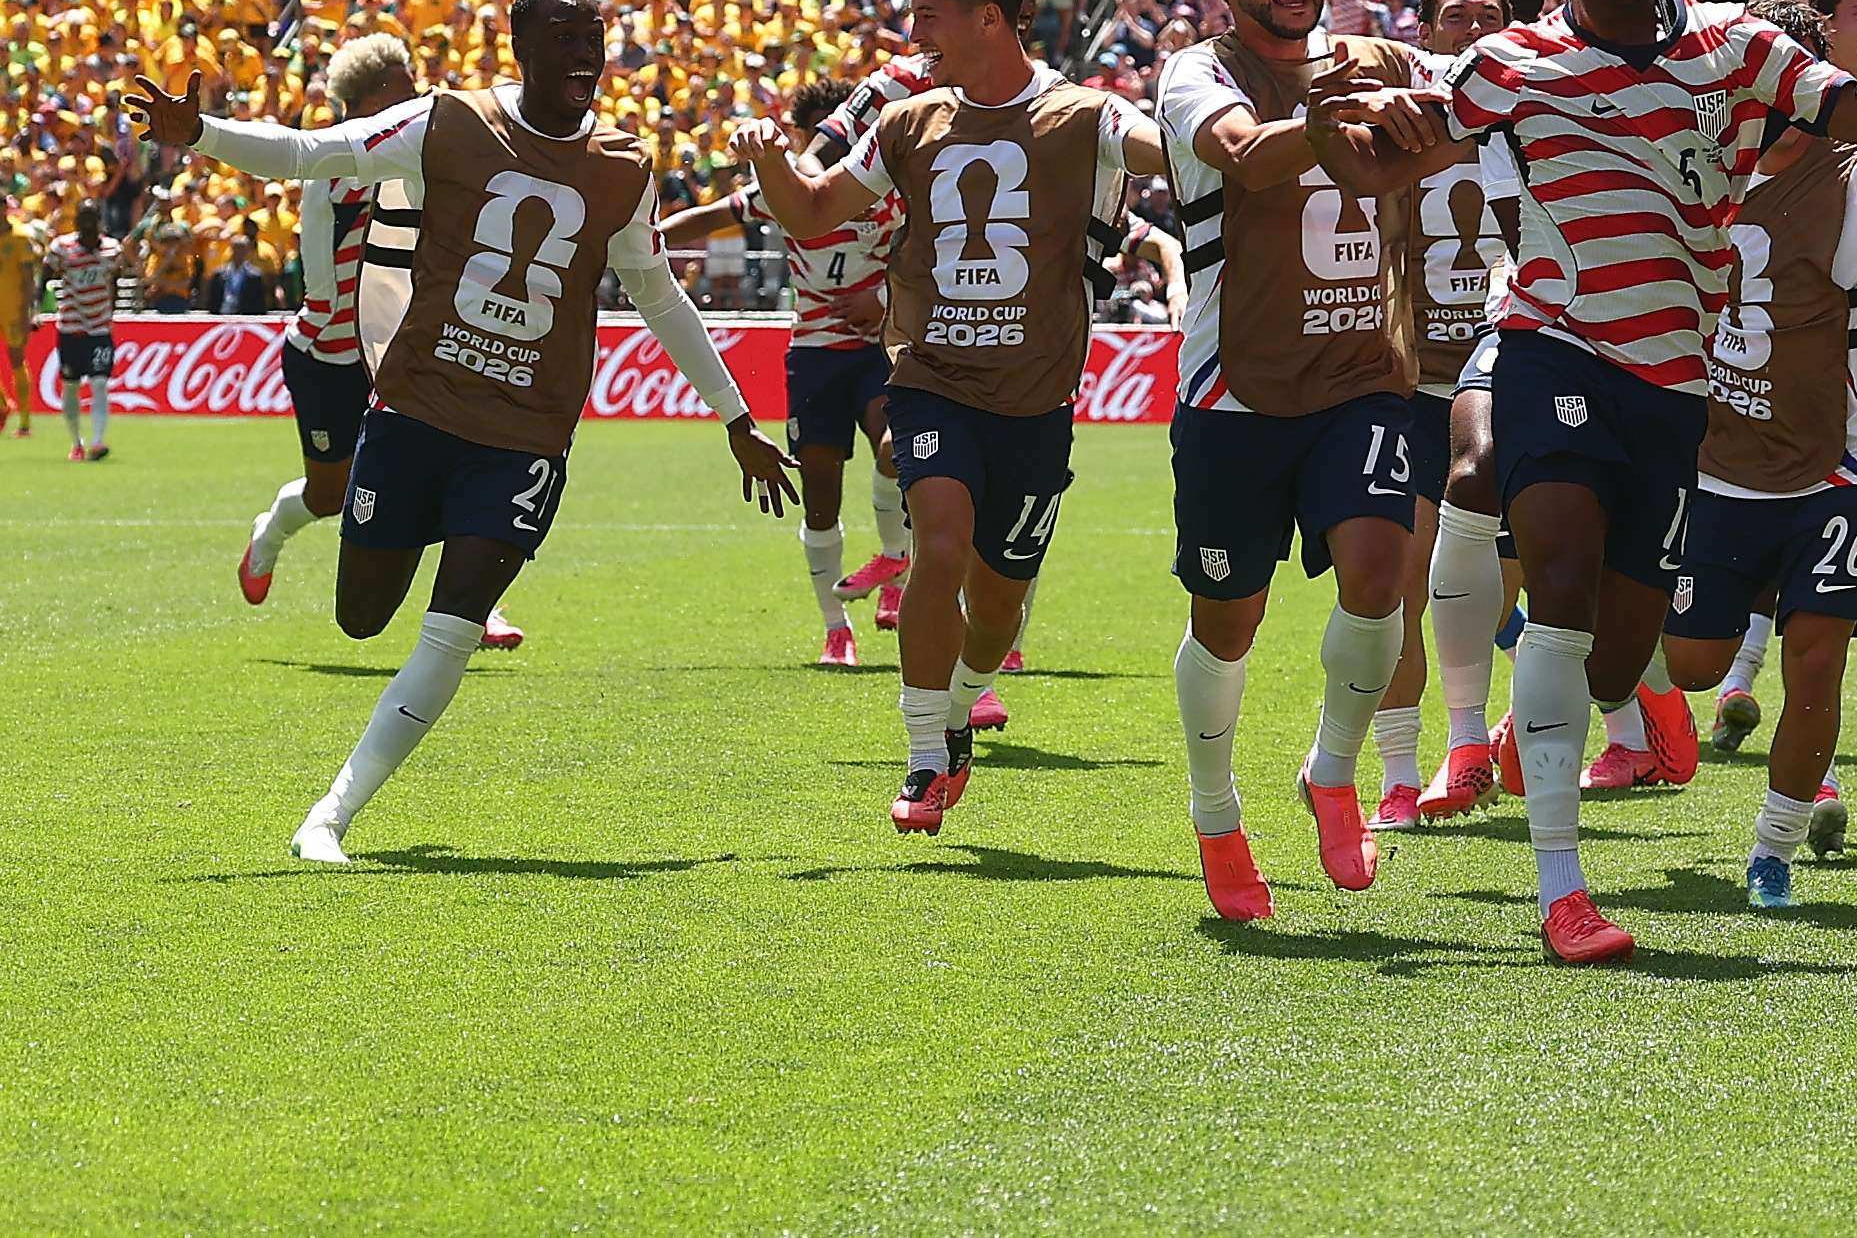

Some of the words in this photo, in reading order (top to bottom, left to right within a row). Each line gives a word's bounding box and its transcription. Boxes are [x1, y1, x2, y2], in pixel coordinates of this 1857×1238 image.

[1334, 241, 1375, 263] FIFA
[827, 251, 847, 286] 4
[955, 267, 1001, 285] FIFA
[1302, 286, 1370, 306] WORLD
[480, 299, 527, 327] FIFA
[931, 304, 990, 321] WORLD
[992, 306, 1028, 321] CUP
[1425, 308, 1485, 320] WORLD
[442, 322, 505, 355] WORLD
[506, 346, 541, 364] CUP
[924, 321, 1025, 347] 2026
[1721, 330, 1747, 355] FIFA
[433, 338, 535, 387] 2026
[1710, 364, 1741, 386] ORLD
[1741, 376, 1773, 395] CUP
[1708, 379, 1772, 421] 026
[1362, 424, 1411, 483] 15
[1005, 492, 1060, 546] 14
